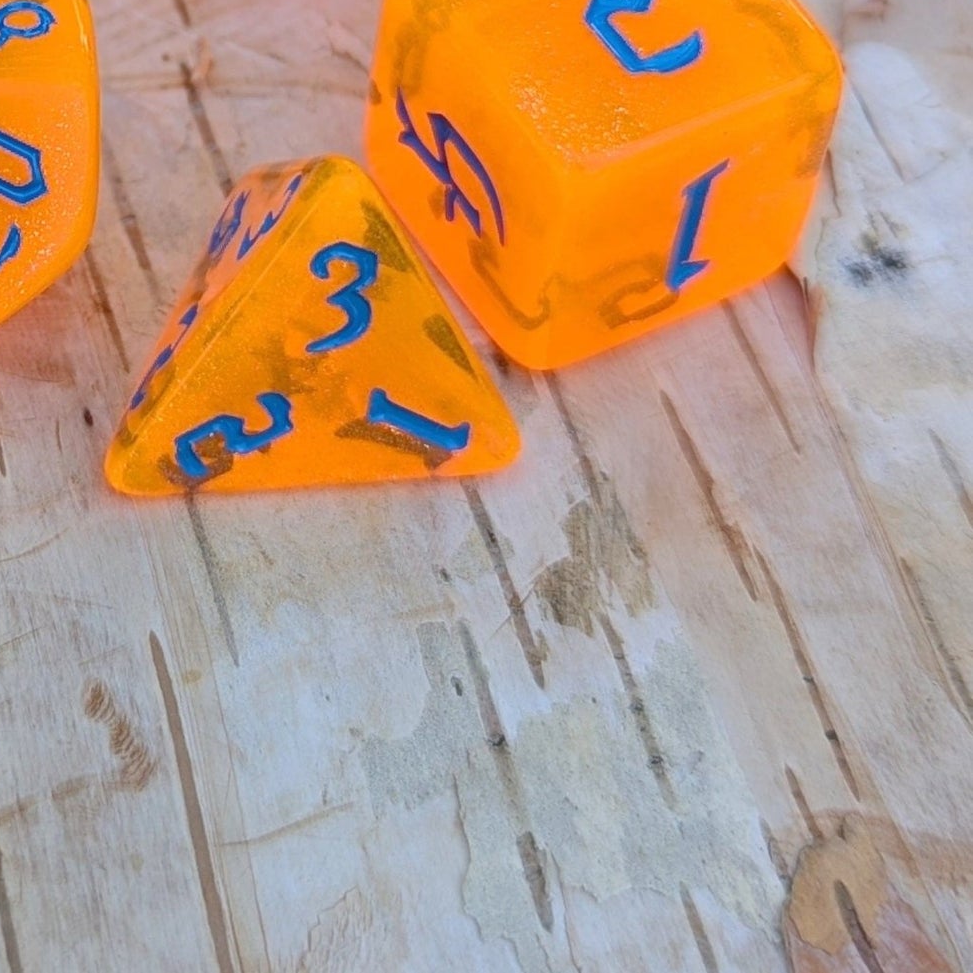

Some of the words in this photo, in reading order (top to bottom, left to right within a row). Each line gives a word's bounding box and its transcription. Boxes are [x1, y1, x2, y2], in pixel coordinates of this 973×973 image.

[396, 86, 505, 248] 4
[666, 158, 730, 292] 1
[305, 241, 378, 353] 3
[174, 392, 294, 478] 2
[367, 388, 471, 453] 1
